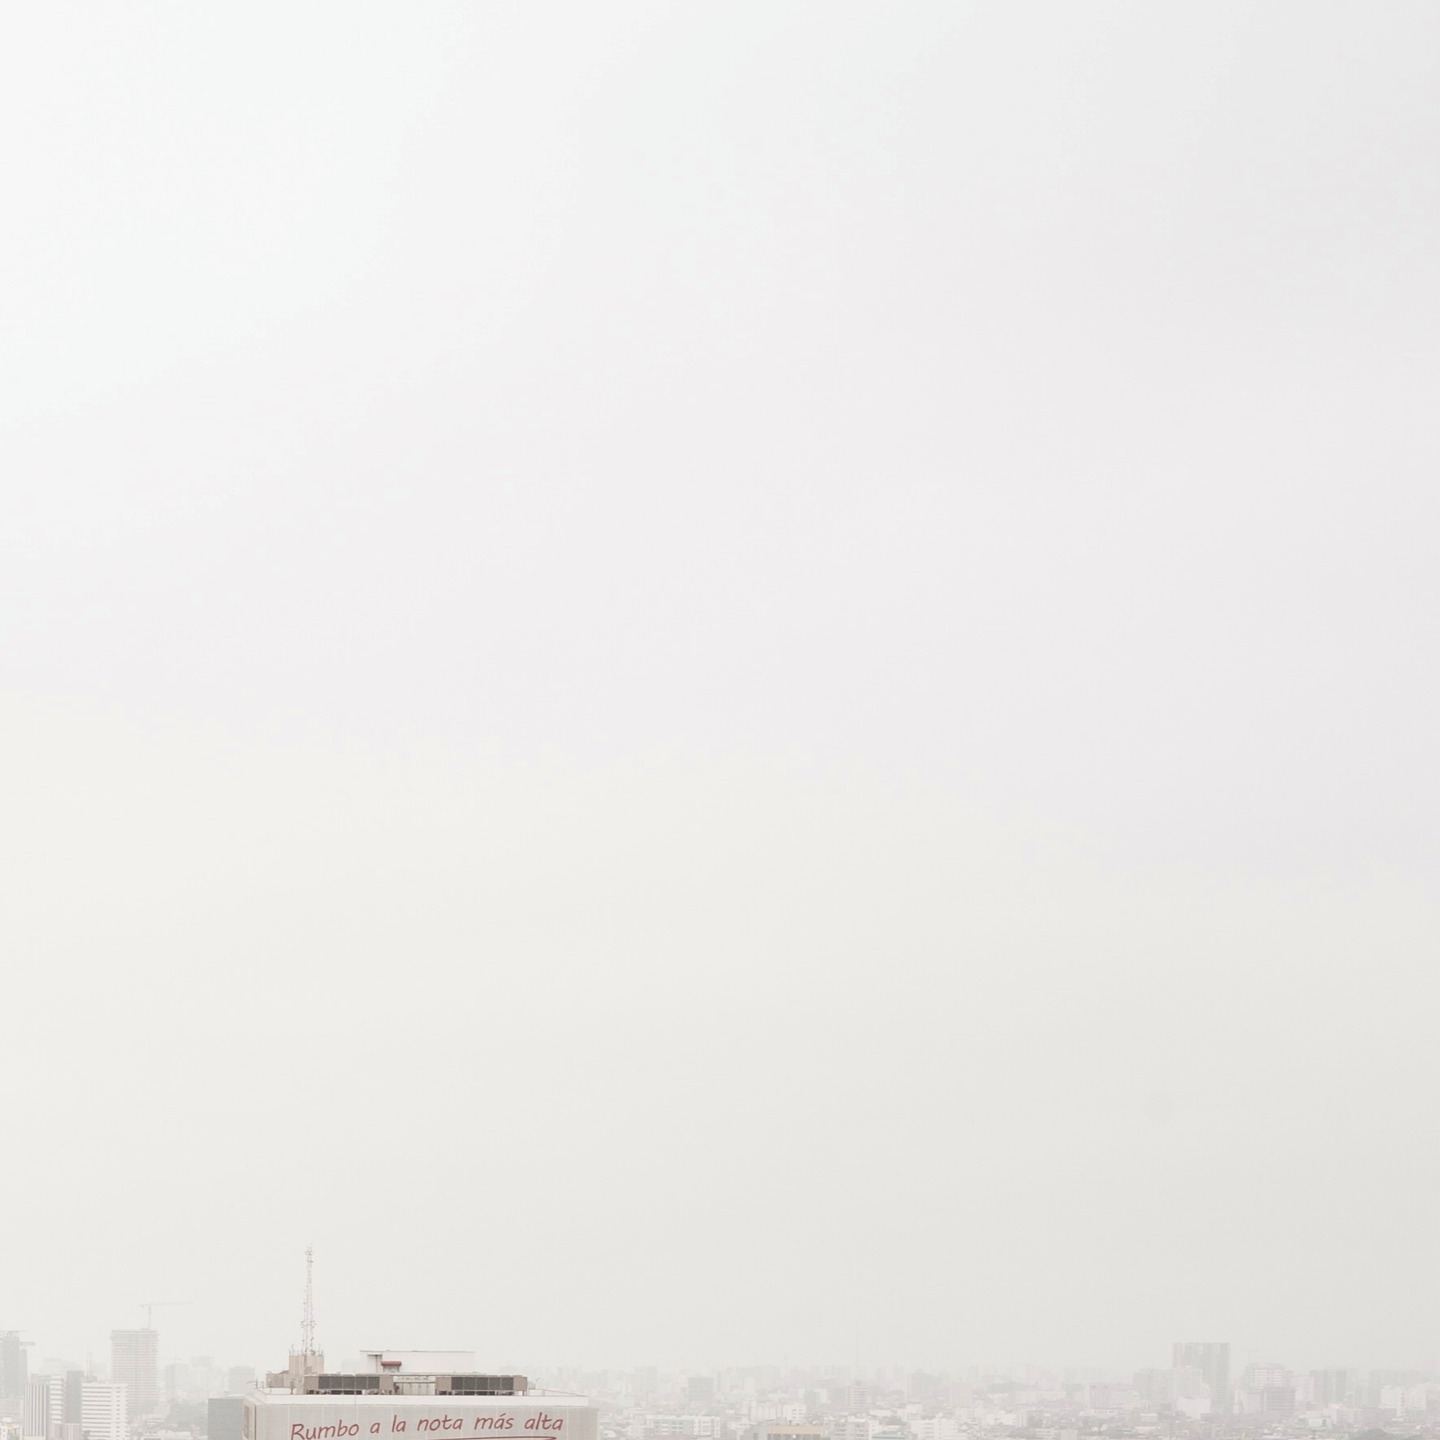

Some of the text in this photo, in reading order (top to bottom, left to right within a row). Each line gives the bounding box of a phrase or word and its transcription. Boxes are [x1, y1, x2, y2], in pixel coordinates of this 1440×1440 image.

[369, 1421, 381, 1434] a
[391, 1414, 406, 1433] la
[416, 1414, 463, 1431] nota
[473, 1412, 514, 1430] más
[524, 1411, 563, 1431] alta
